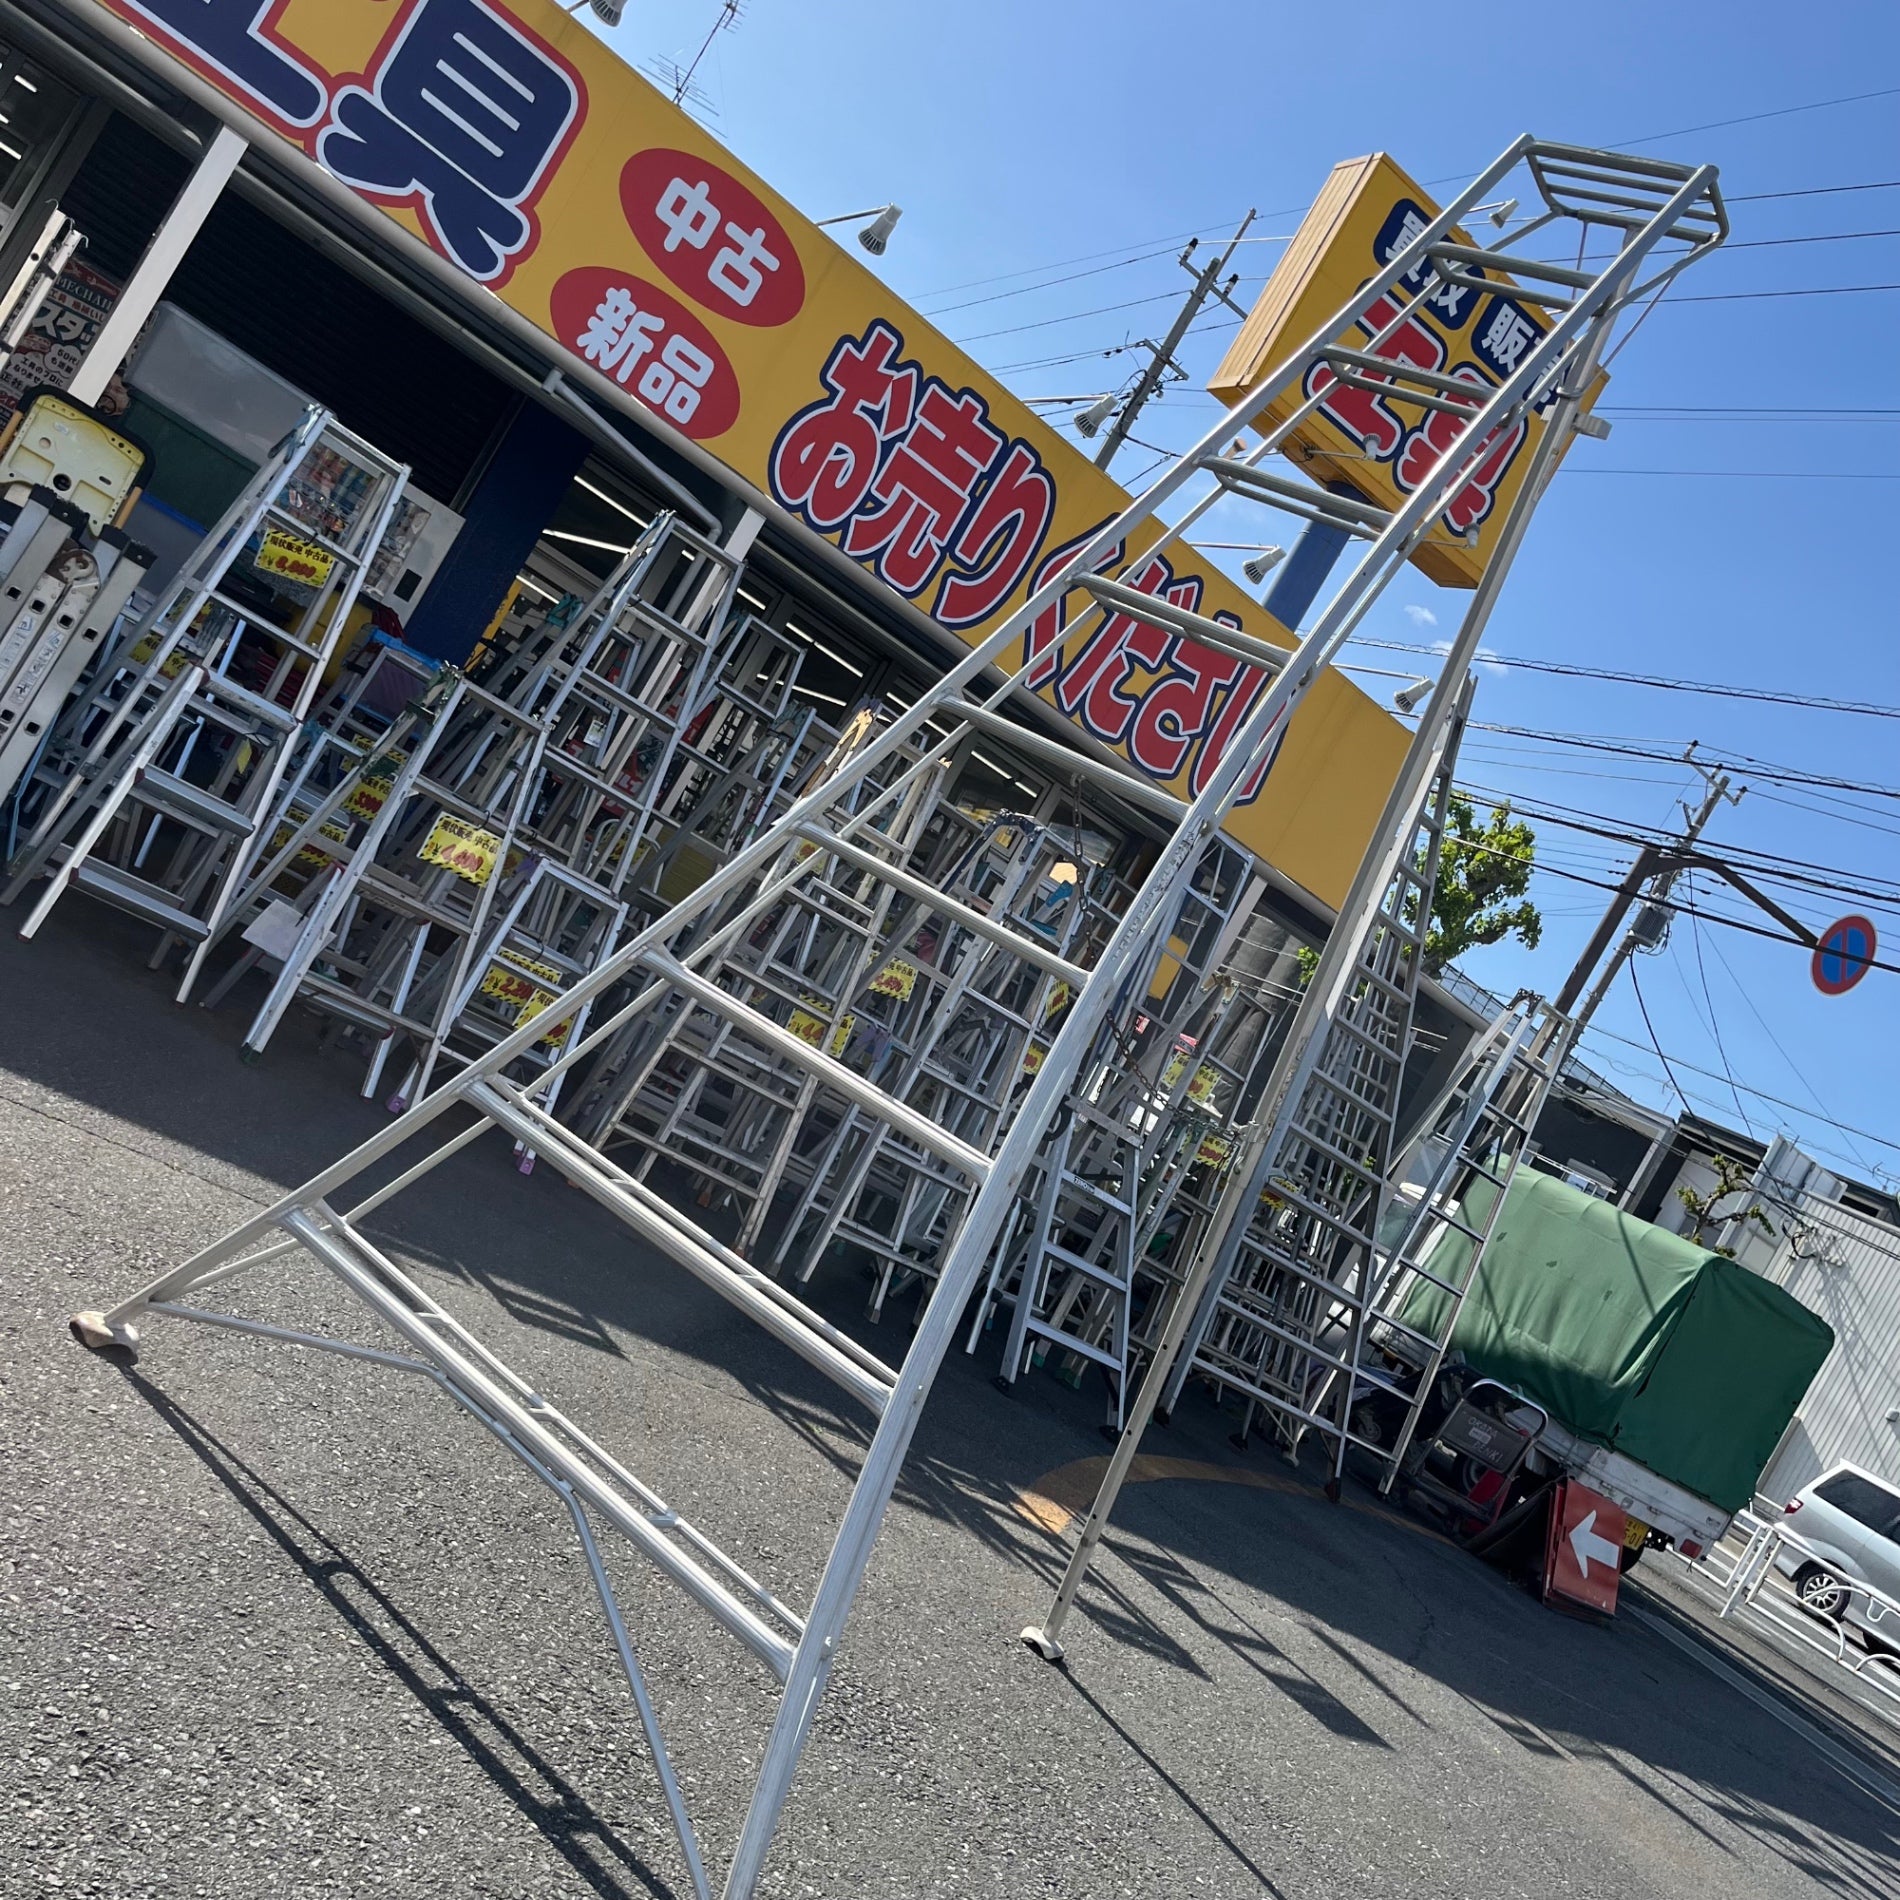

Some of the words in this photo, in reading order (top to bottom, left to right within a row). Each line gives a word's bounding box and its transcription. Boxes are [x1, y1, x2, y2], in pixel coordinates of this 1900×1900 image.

[654, 176, 781, 307] 中古
[576, 287, 714, 425] 新品
[304, 548, 329, 564] 中古品
